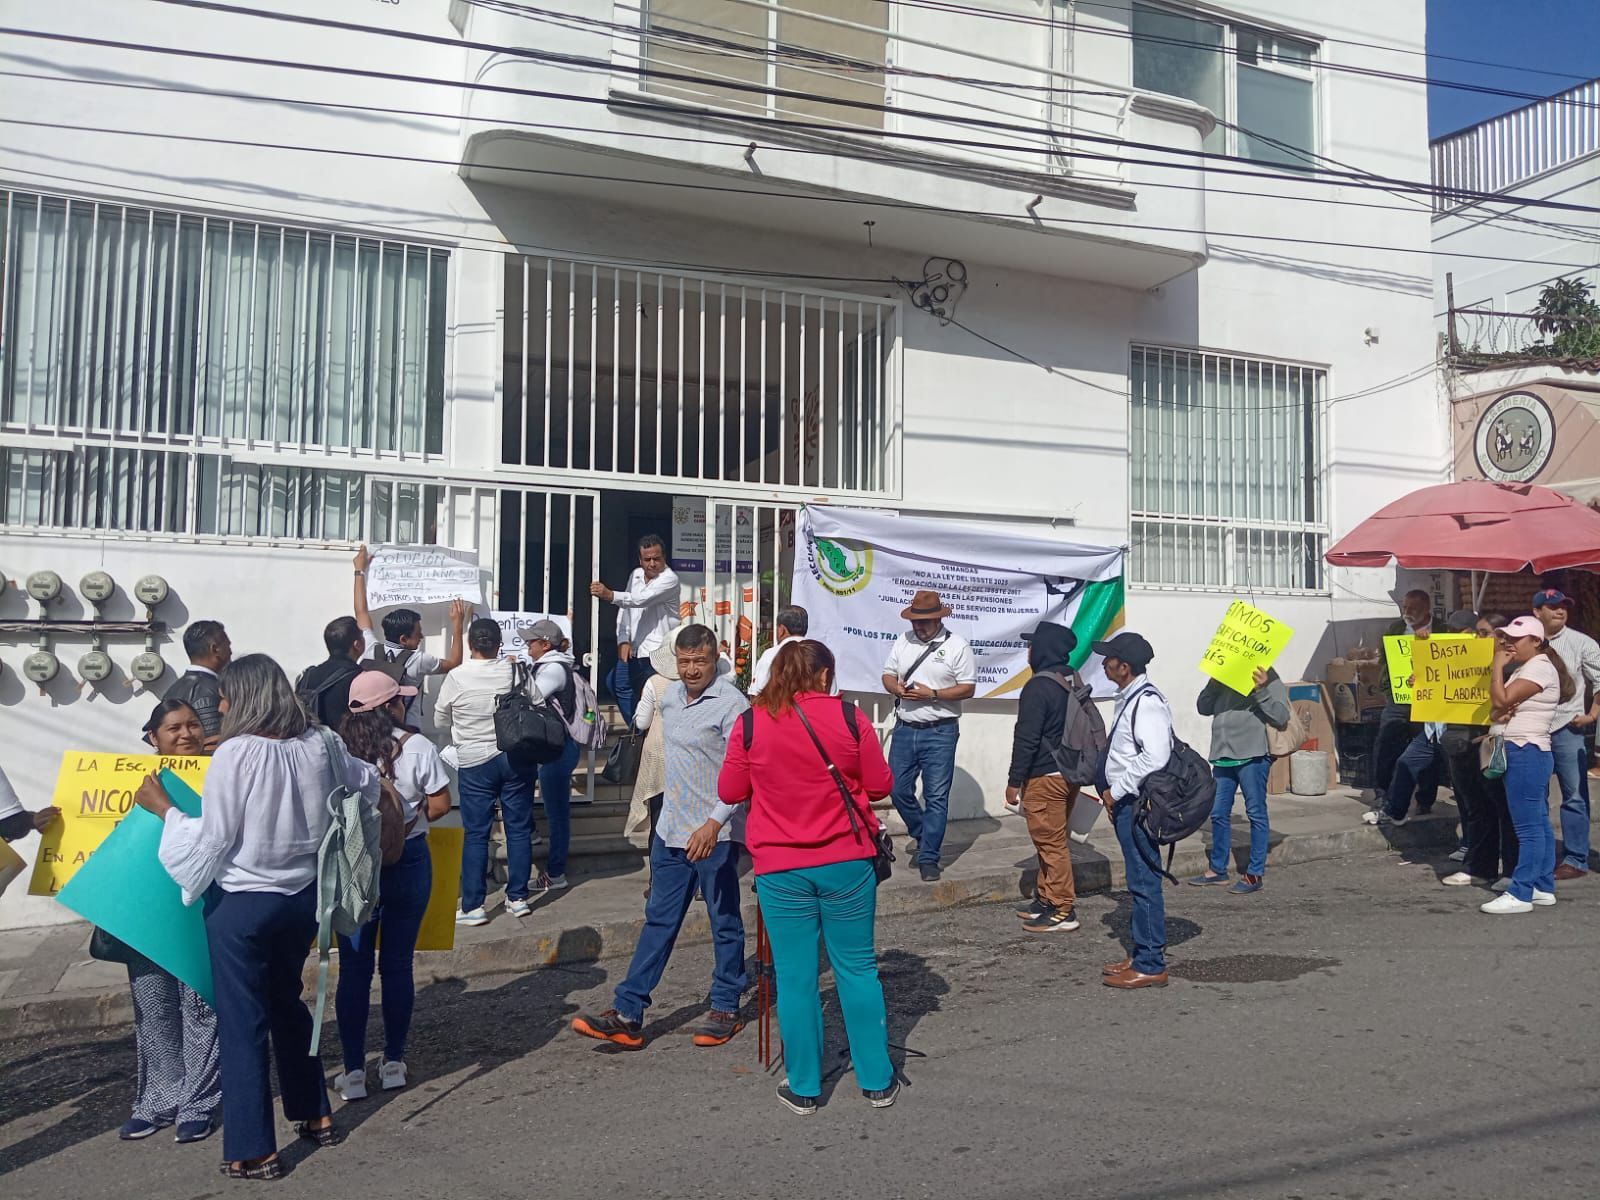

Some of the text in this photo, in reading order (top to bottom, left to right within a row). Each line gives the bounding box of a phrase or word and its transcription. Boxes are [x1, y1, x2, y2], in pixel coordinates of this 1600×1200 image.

[863, 631, 878, 639] LOS
[970, 639, 1013, 648] EDUCACIÓN
[76, 758, 98, 772] LA
